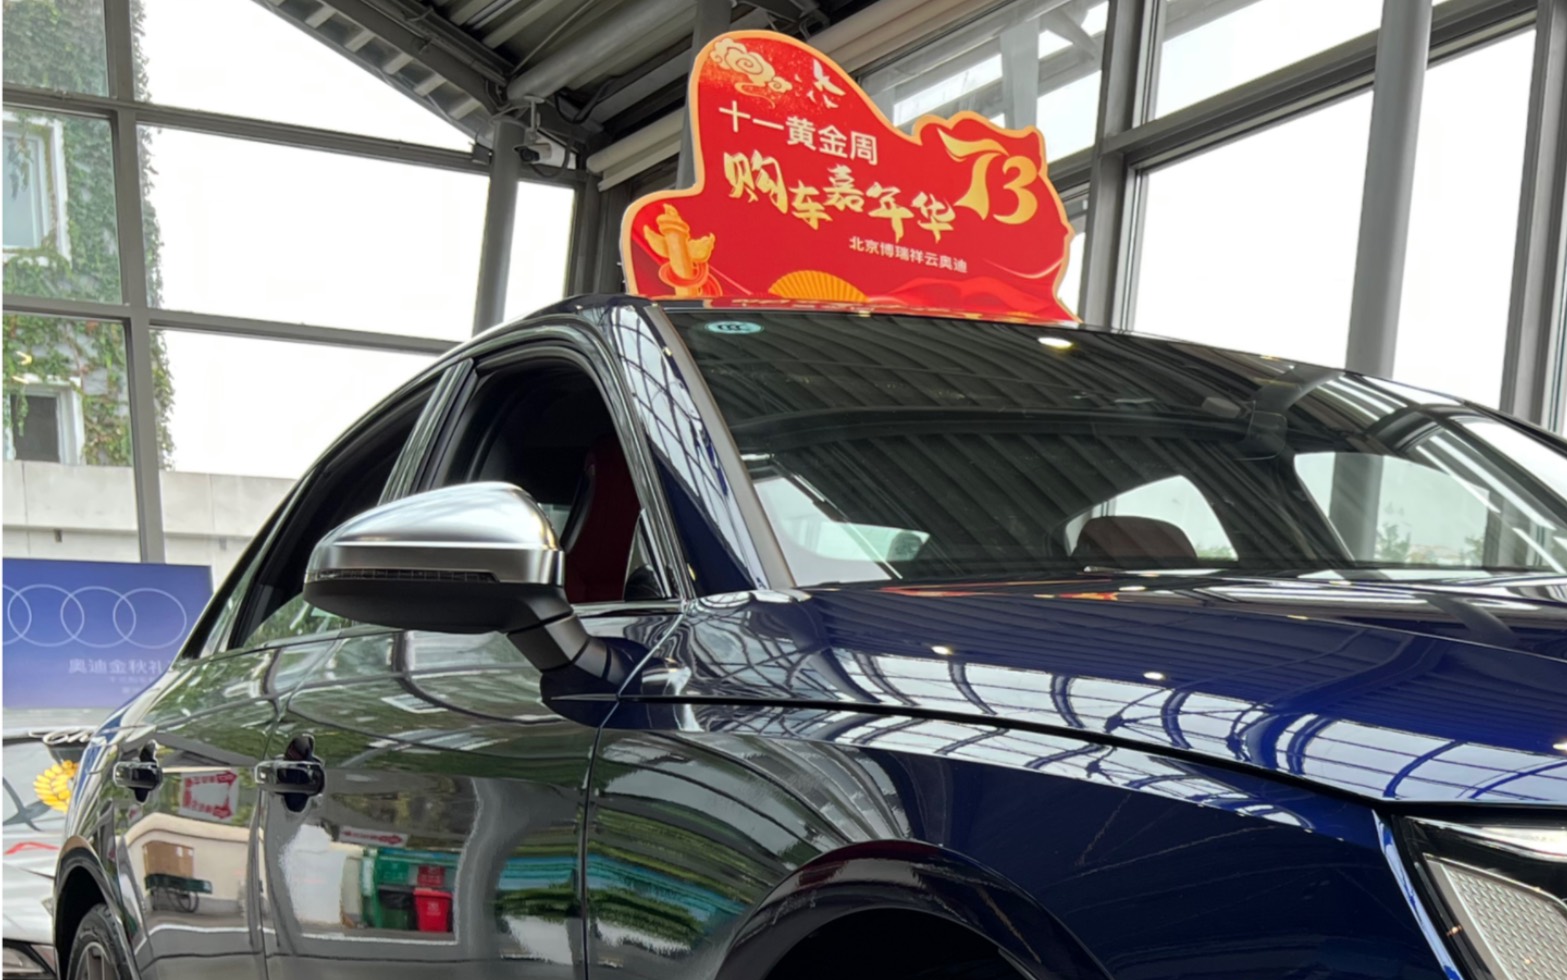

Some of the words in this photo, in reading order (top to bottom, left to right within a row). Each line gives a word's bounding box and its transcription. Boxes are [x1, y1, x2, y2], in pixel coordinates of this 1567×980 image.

[718, 100, 878, 165] 十一黄金周
[723, 149, 956, 243] 购车嘉年华
[937, 127, 1038, 224] 73
[848, 236, 968, 273] 北京博瑞祥云奥迪
[68, 658, 172, 674] 奥迪金秋礼
